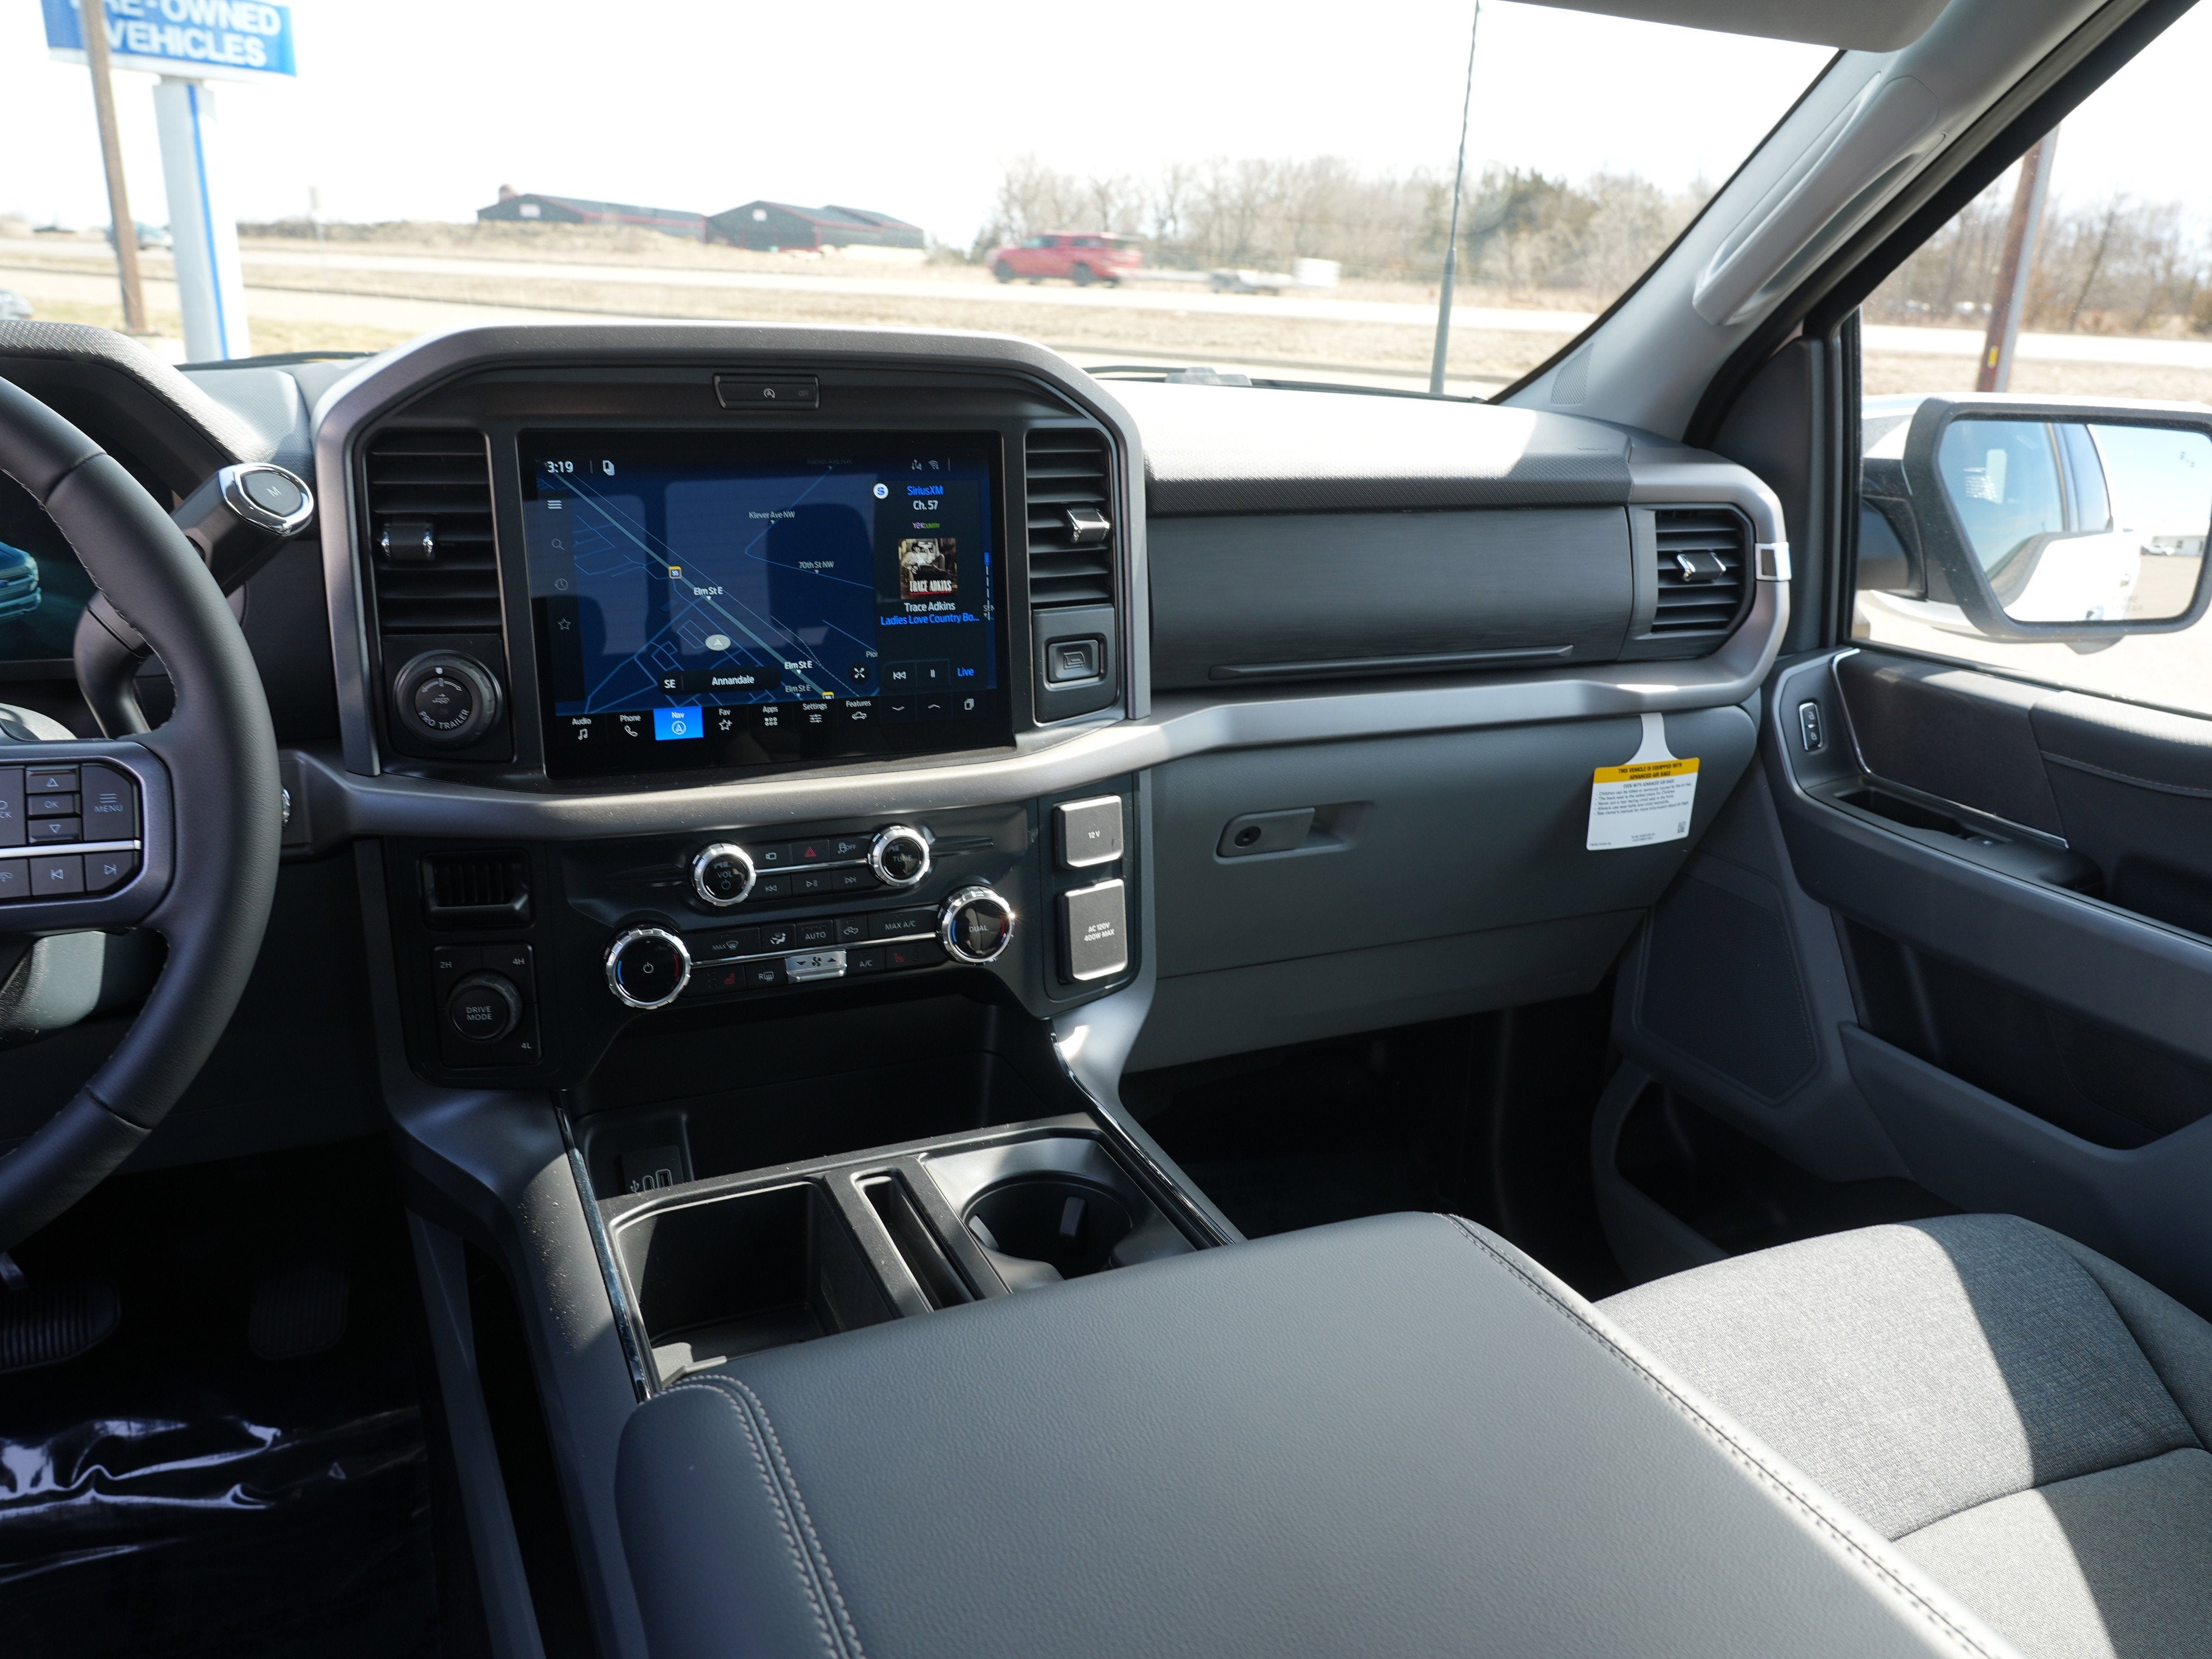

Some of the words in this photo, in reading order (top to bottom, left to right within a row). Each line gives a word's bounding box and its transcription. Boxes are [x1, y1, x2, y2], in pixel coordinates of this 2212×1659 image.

[69, 0, 281, 37] E-OWNED
[102, 18, 267, 68] VEHICLES
[547, 461, 574, 473] 3:19
[907, 485, 943, 496] SiriusXM
[913, 500, 927, 510] Ch.
[927, 500, 939, 510] 57
[770, 510, 783, 518] Ave
[783, 510, 795, 518] NW
[799, 560, 814, 569] 70th
[822, 560, 834, 568] NW
[909, 580, 929, 592] TRACE
[929, 579, 952, 592] ADKINS
[693, 586, 708, 596] Elm
[708, 586, 717, 595] St
[717, 586, 723, 595] E
[903, 602, 927, 612] Trace
[928, 601, 956, 612] Adkins
[880, 615, 907, 626] Ladies
[908, 615, 928, 624] Love
[929, 613, 962, 624] Country
[784, 661, 798, 670] Elm
[798, 660, 807, 669] St
[807, 660, 813, 669] E
[957, 667, 974, 677] Live
[664, 679, 676, 689] SE
[712, 675, 754, 686] Annandale
[763, 705, 778, 713] Apps
[419, 711, 436, 726] PRO
[439, 709, 470, 730] TRAILER
[620, 714, 641, 723] Phone
[892, 854, 913, 862] TUNE
[717, 870, 733, 879] VOL
[885, 922, 902, 930] MAX
[903, 920, 916, 928] A/C
[968, 925, 989, 933] DUAL
[1088, 925, 1096, 933] AC
[1096, 922, 1110, 931] 120V
[805, 932, 826, 940] AUTO
[1084, 932, 1101, 942] 400W
[1102, 928, 1115, 938] MAX
[859, 960, 873, 968] A/C
